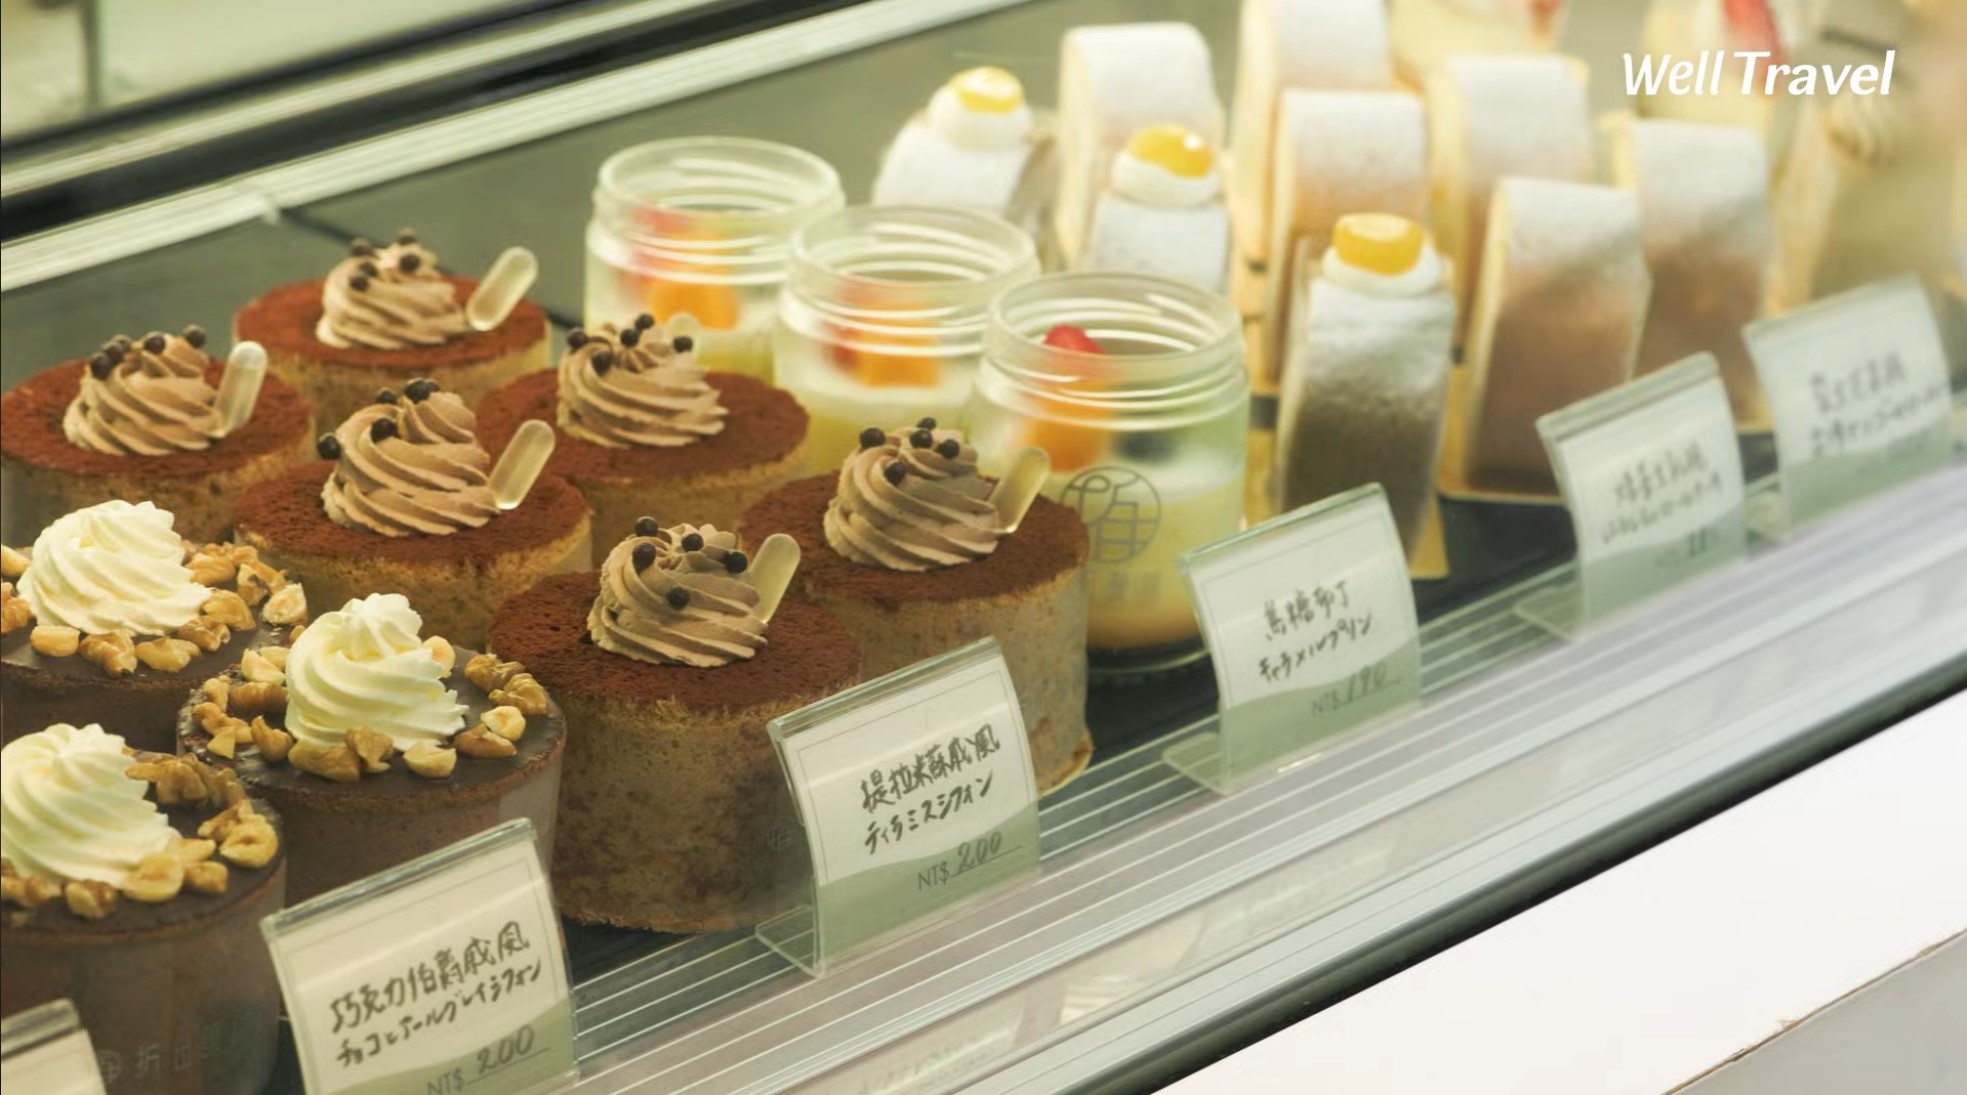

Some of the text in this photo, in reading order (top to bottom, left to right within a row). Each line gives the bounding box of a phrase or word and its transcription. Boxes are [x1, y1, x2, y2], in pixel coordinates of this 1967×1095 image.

[1347, 661, 1388, 703] 190
[917, 831, 1003, 892] NT$ 200
[426, 1024, 536, 1095] NT$ 200
